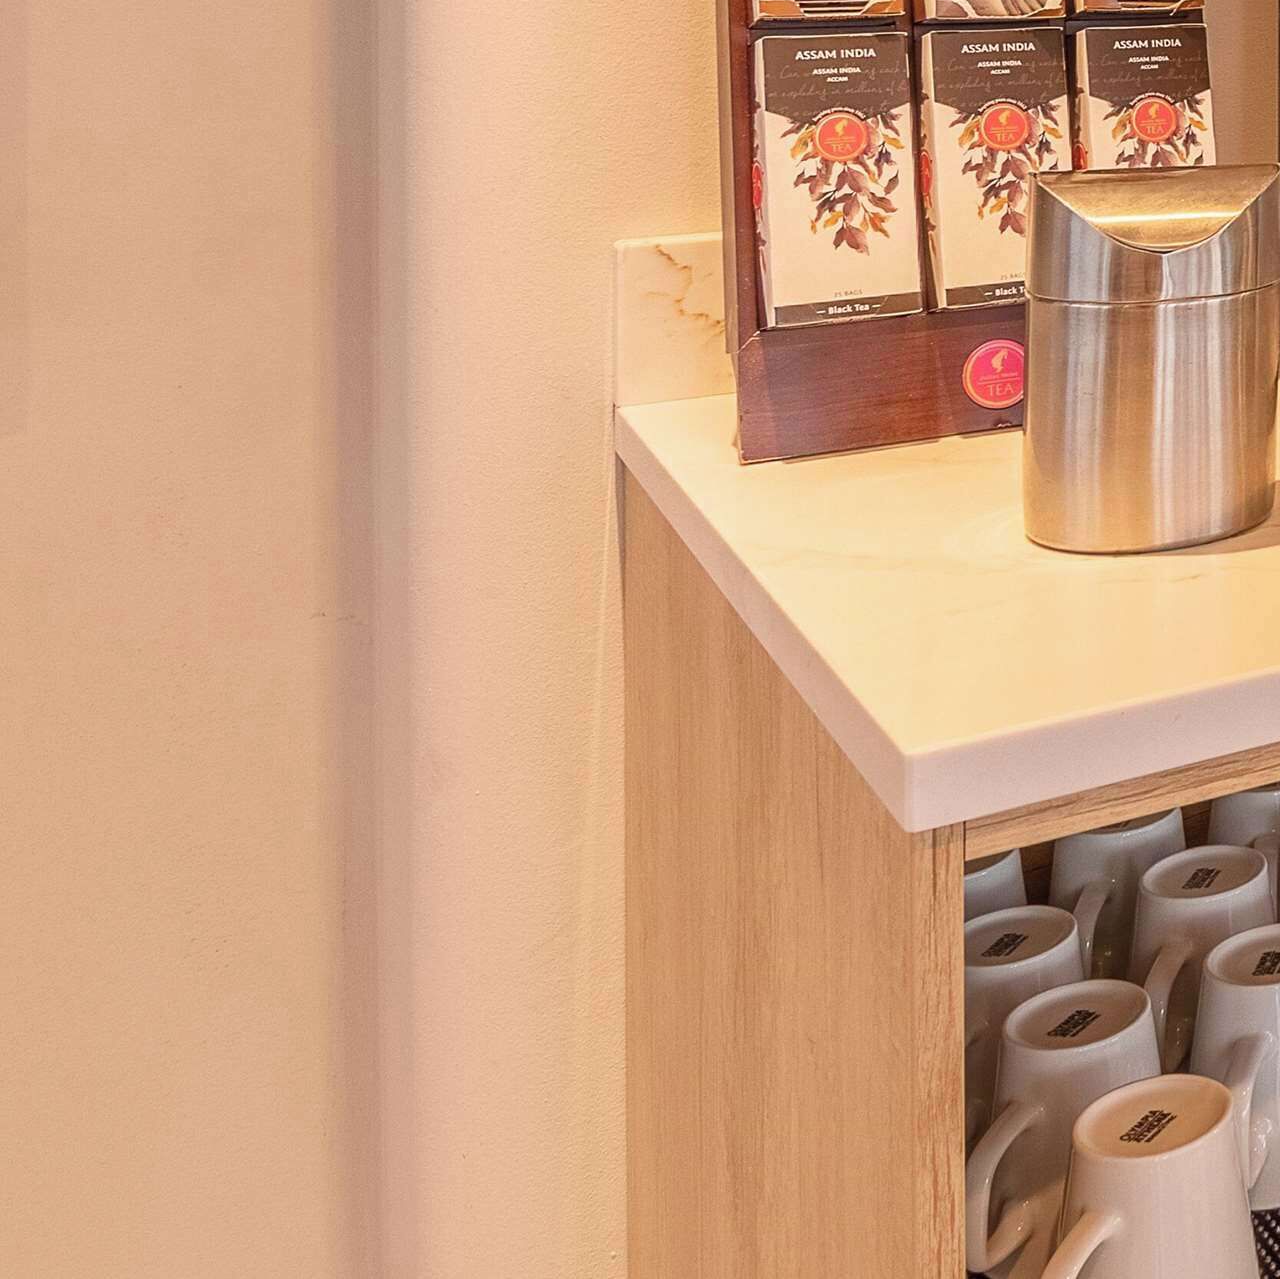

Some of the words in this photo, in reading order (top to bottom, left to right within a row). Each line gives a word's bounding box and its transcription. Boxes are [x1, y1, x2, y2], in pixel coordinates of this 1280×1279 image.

[961, 43, 1000, 54] ASSAM
[1002, 42, 1036, 52] INDIA
[1113, 39, 1149, 50] ASSAM
[1151, 38, 1182, 48] INDIA
[795, 49, 837, 60] ASSAM
[840, 48, 877, 58] INDIA
[812, 67, 838, 75] ASSAM
[838, 66, 861, 74] INDIA
[995, 286, 1018, 297] Black
[828, 304, 853, 315] Black
[854, 303, 870, 312] Tea
[987, 383, 1015, 397] TEA
